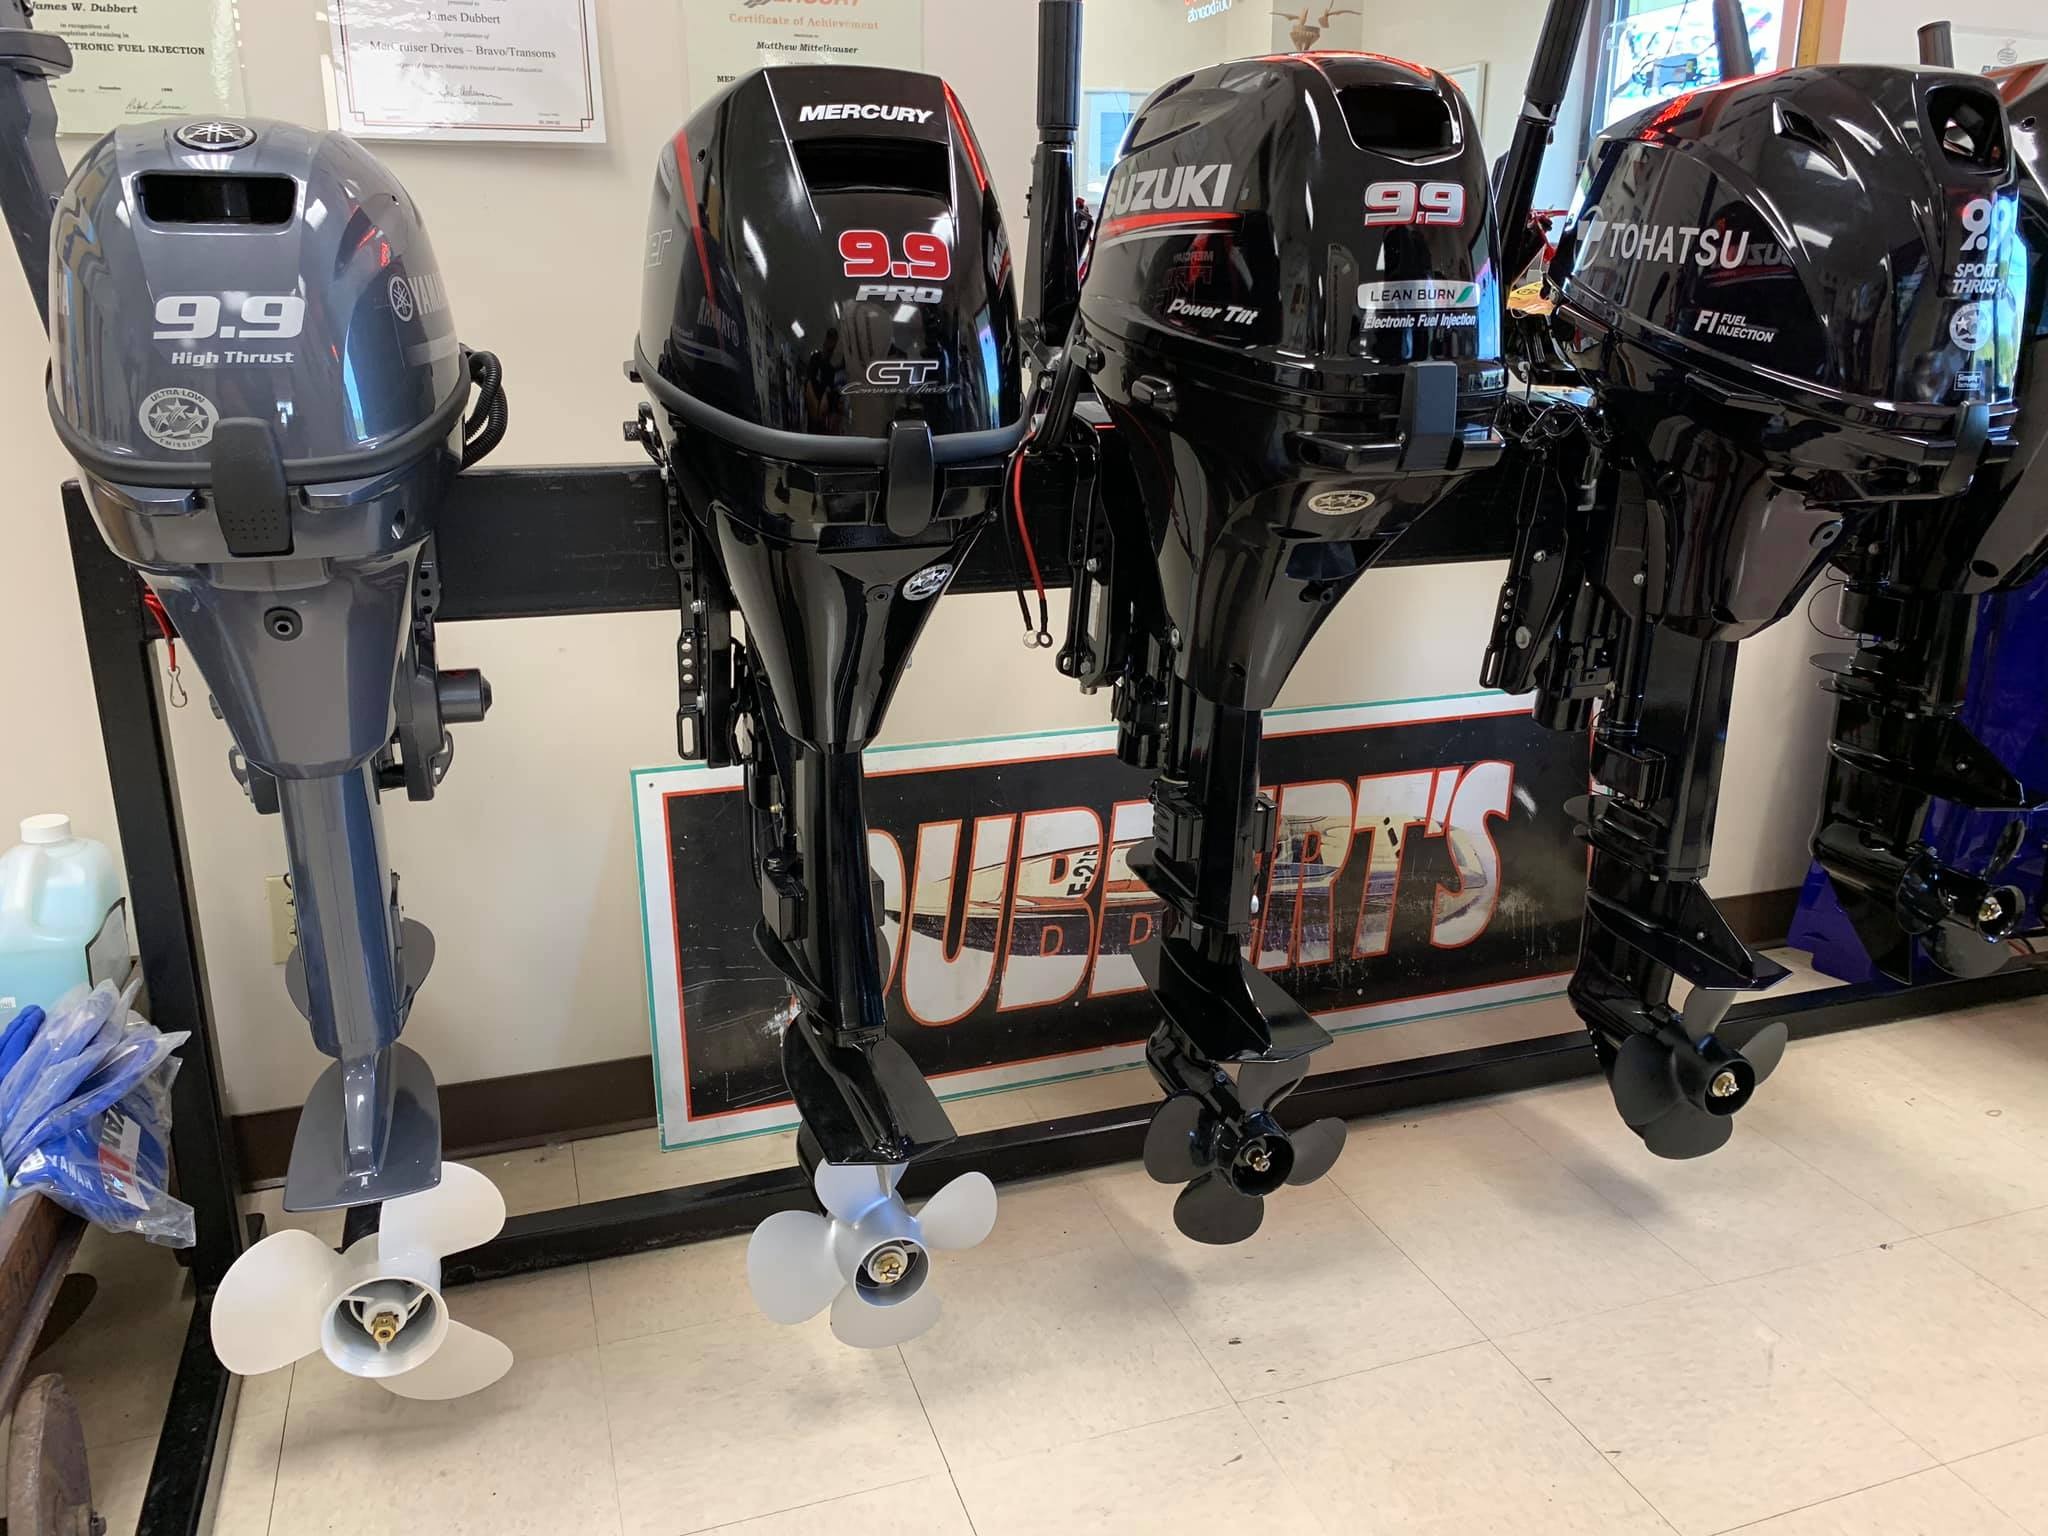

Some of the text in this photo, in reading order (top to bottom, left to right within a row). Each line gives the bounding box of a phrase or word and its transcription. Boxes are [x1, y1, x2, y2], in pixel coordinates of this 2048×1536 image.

[71, 2, 86, 12] W.
[90, 3, 138, 14] Dubbert
[459, 12, 501, 24] Dubbert
[728, 13, 789, 26] Certificate
[793, 16, 804, 26] of
[66, 42, 206, 56] CTRONIC FUEL INJECTION
[430, 42, 464, 54] Drives
[475, 44, 557, 59] Bravo/Transoms
[756, 40, 798, 52] Matthew
[799, 104, 936, 124] MERCURY
[1103, 164, 1232, 217] SUZUKI
[1363, 181, 1465, 226] 9.9
[1608, 221, 1750, 270] TOHATSU
[838, 229, 952, 281] 9.9
[1954, 262, 1998, 278] SPORT
[1951, 277, 2001, 294] THRUST
[855, 284, 944, 305] PRO
[1370, 288, 1456, 303] LEAN BURN
[153, 295, 306, 340] 9.9
[1166, 298, 1259, 325] Power Tilt
[1720, 313, 1747, 327] FUEL
[1363, 312, 1477, 330] Electronic Fuel Injection
[1693, 309, 1721, 334] FI
[1715, 324, 1776, 343] INJECTION
[171, 351, 295, 368] High Thrust
[150, 389, 206, 404] ULTRA LOW
[45, 1154, 94, 1192] YAMAH
